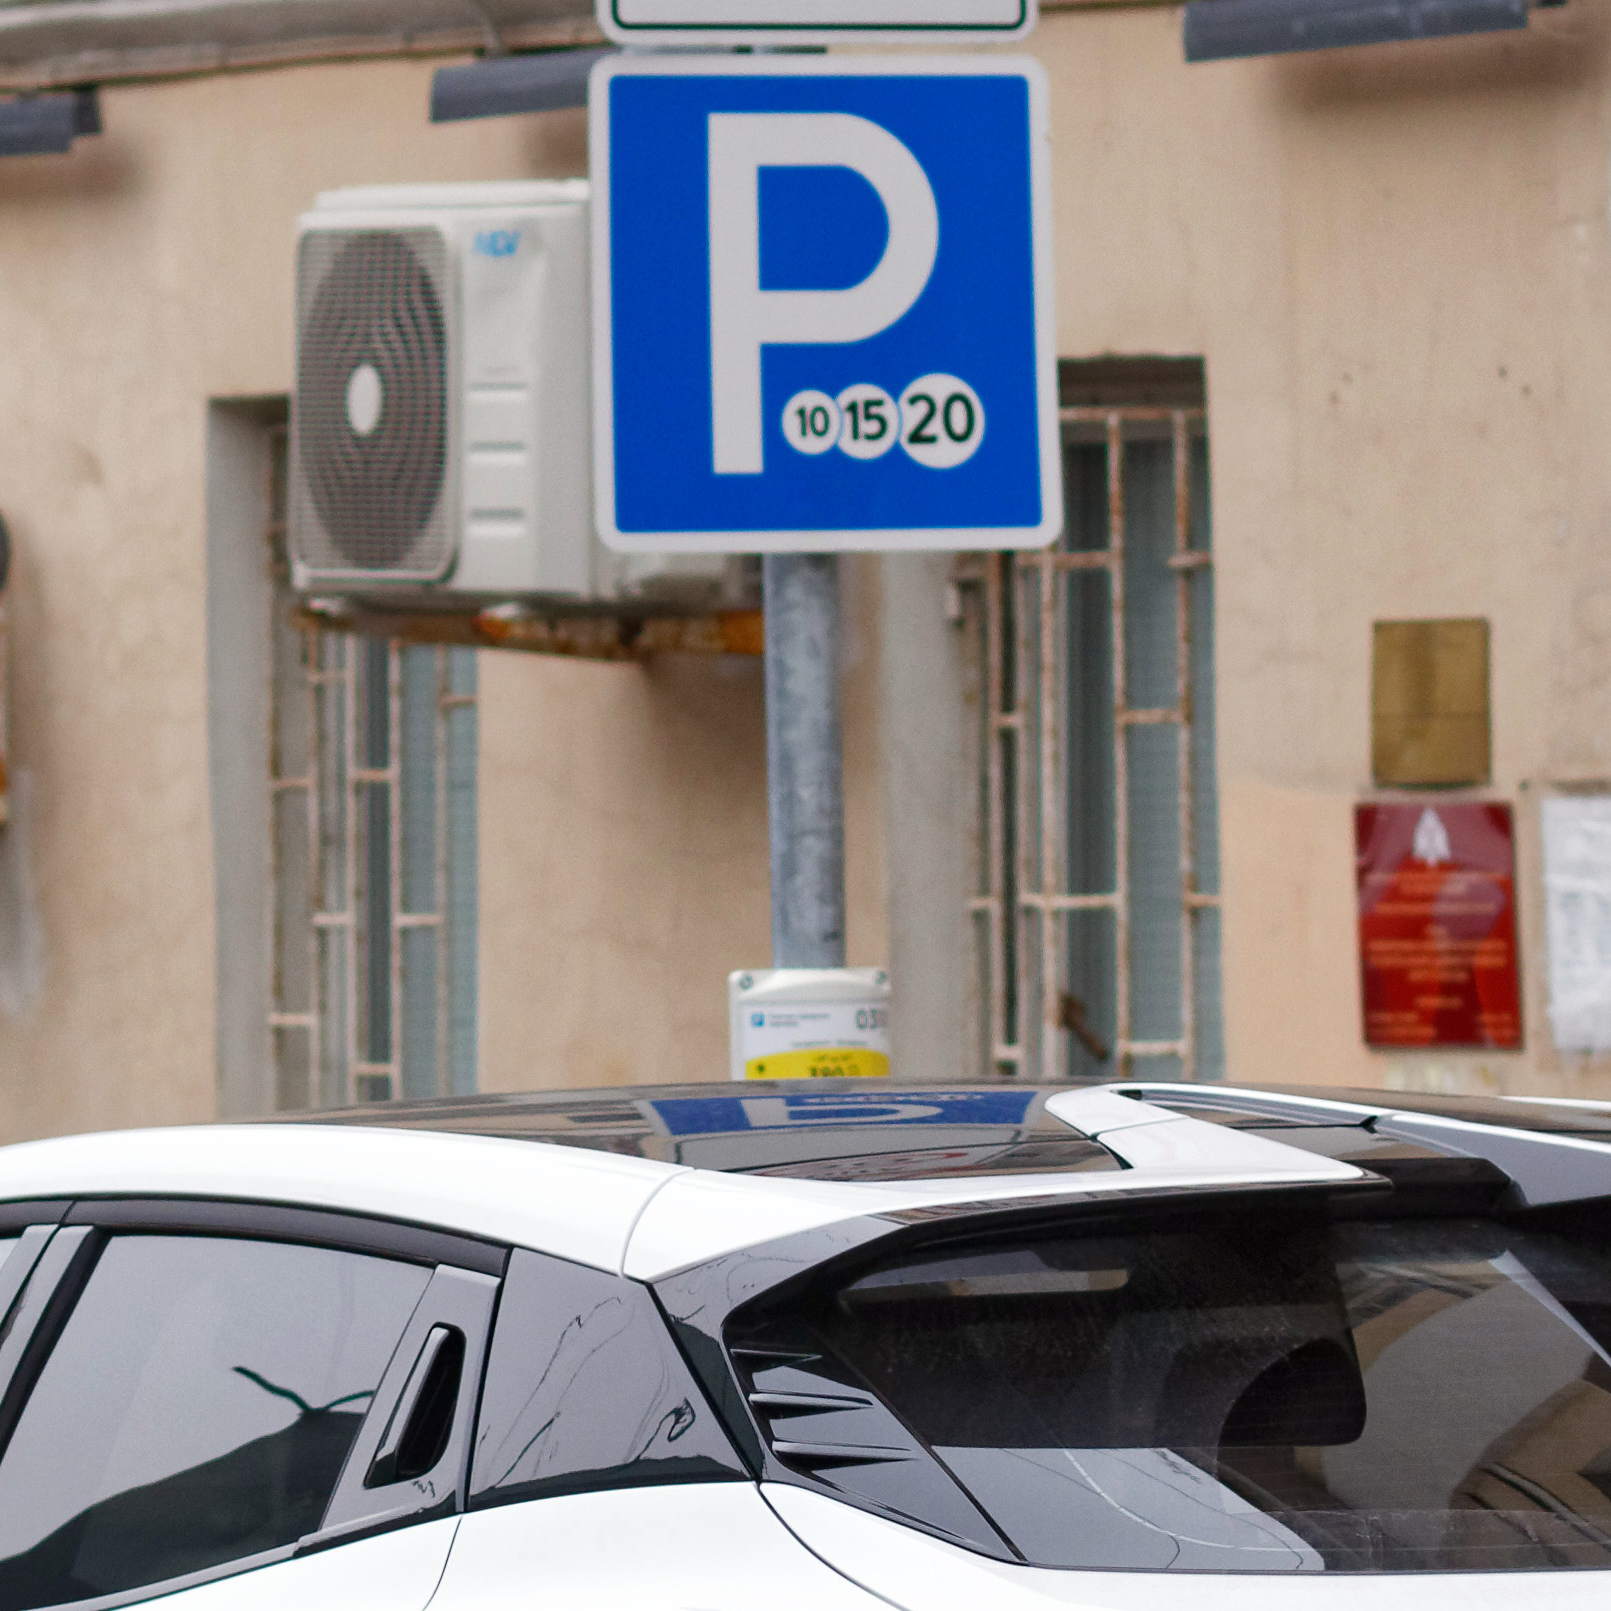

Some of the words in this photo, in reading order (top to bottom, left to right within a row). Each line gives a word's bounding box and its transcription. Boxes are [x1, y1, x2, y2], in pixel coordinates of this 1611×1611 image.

[707, 112, 940, 475] P
[795, 406, 830, 437] 10
[845, 400, 888, 441] 15
[908, 393, 975, 444] 20
